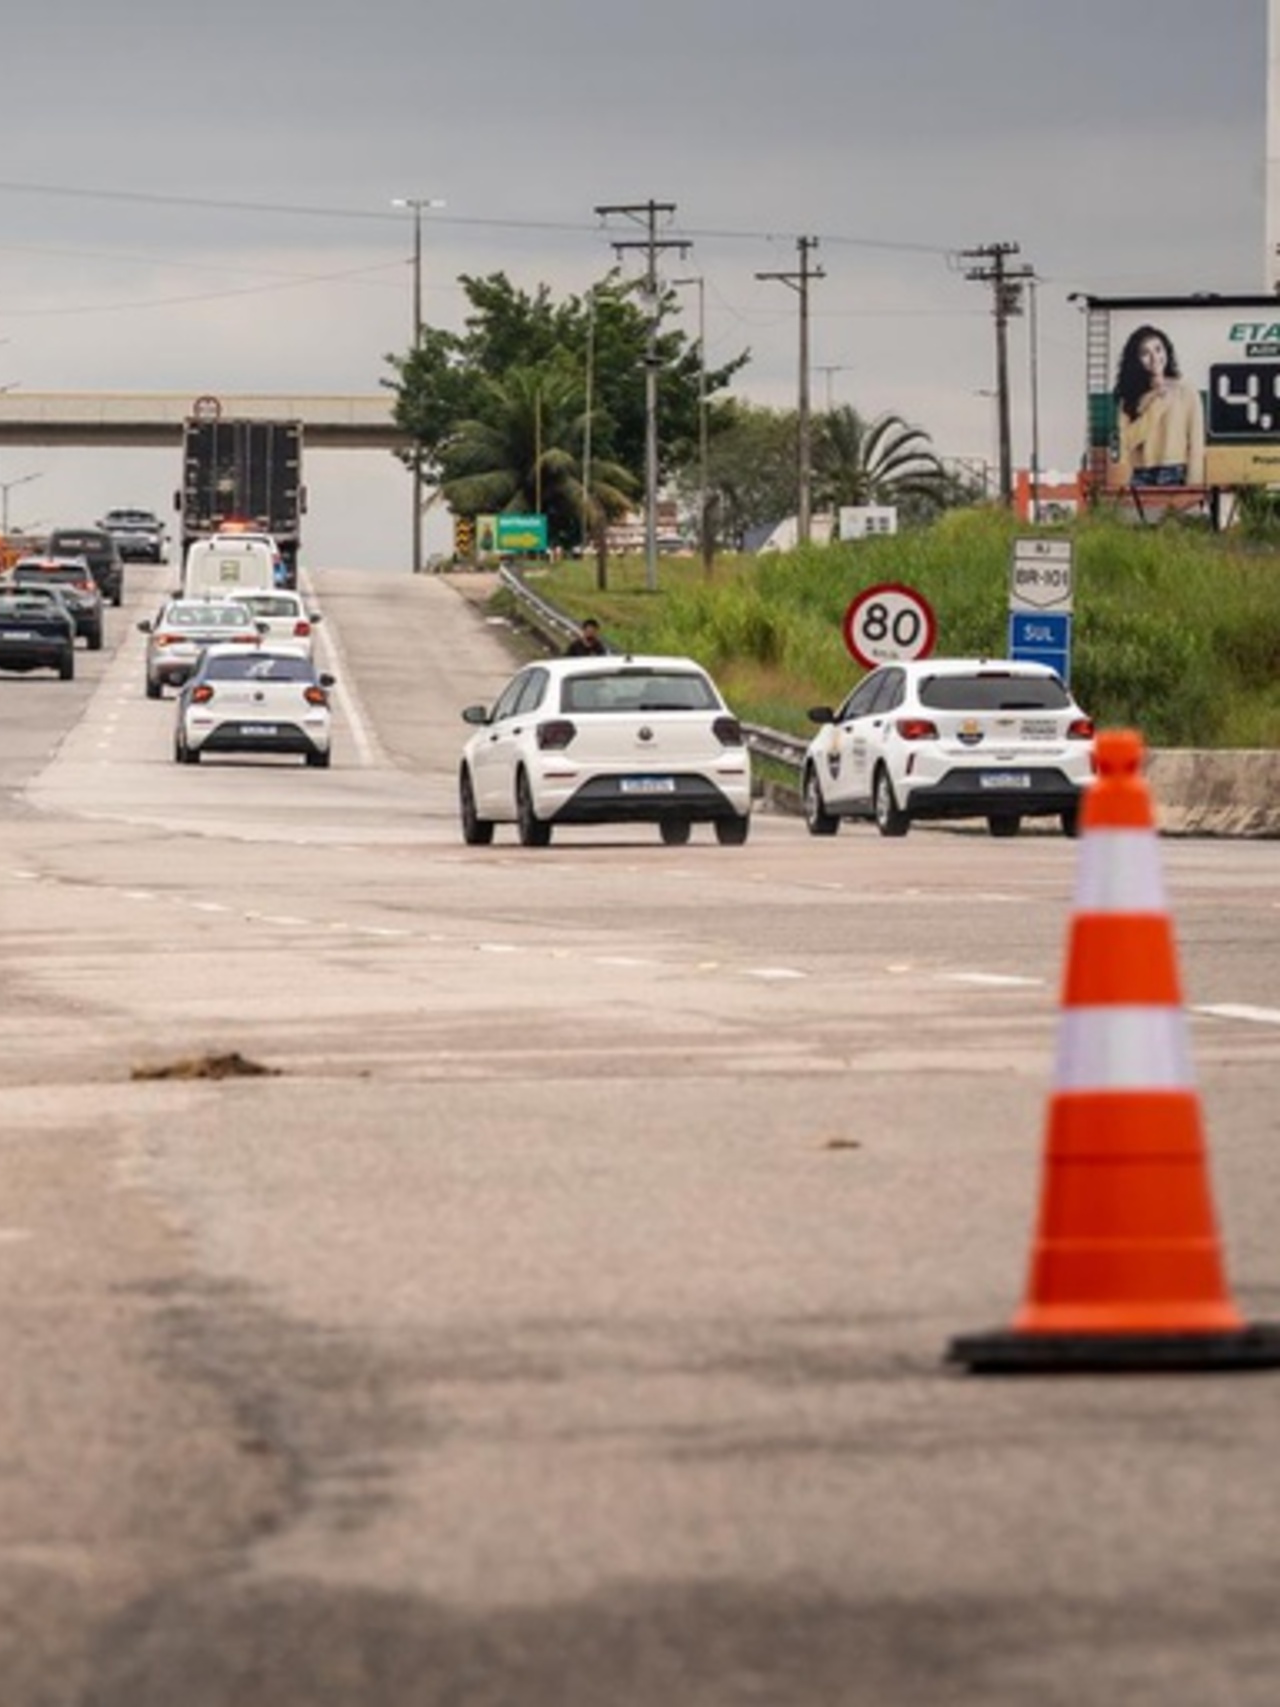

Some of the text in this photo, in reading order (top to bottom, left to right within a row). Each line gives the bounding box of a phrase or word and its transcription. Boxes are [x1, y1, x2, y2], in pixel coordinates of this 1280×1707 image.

[1016, 568, 1068, 587] BR-101
[862, 602, 921, 647] 80
[1023, 624, 1055, 642] SUL
